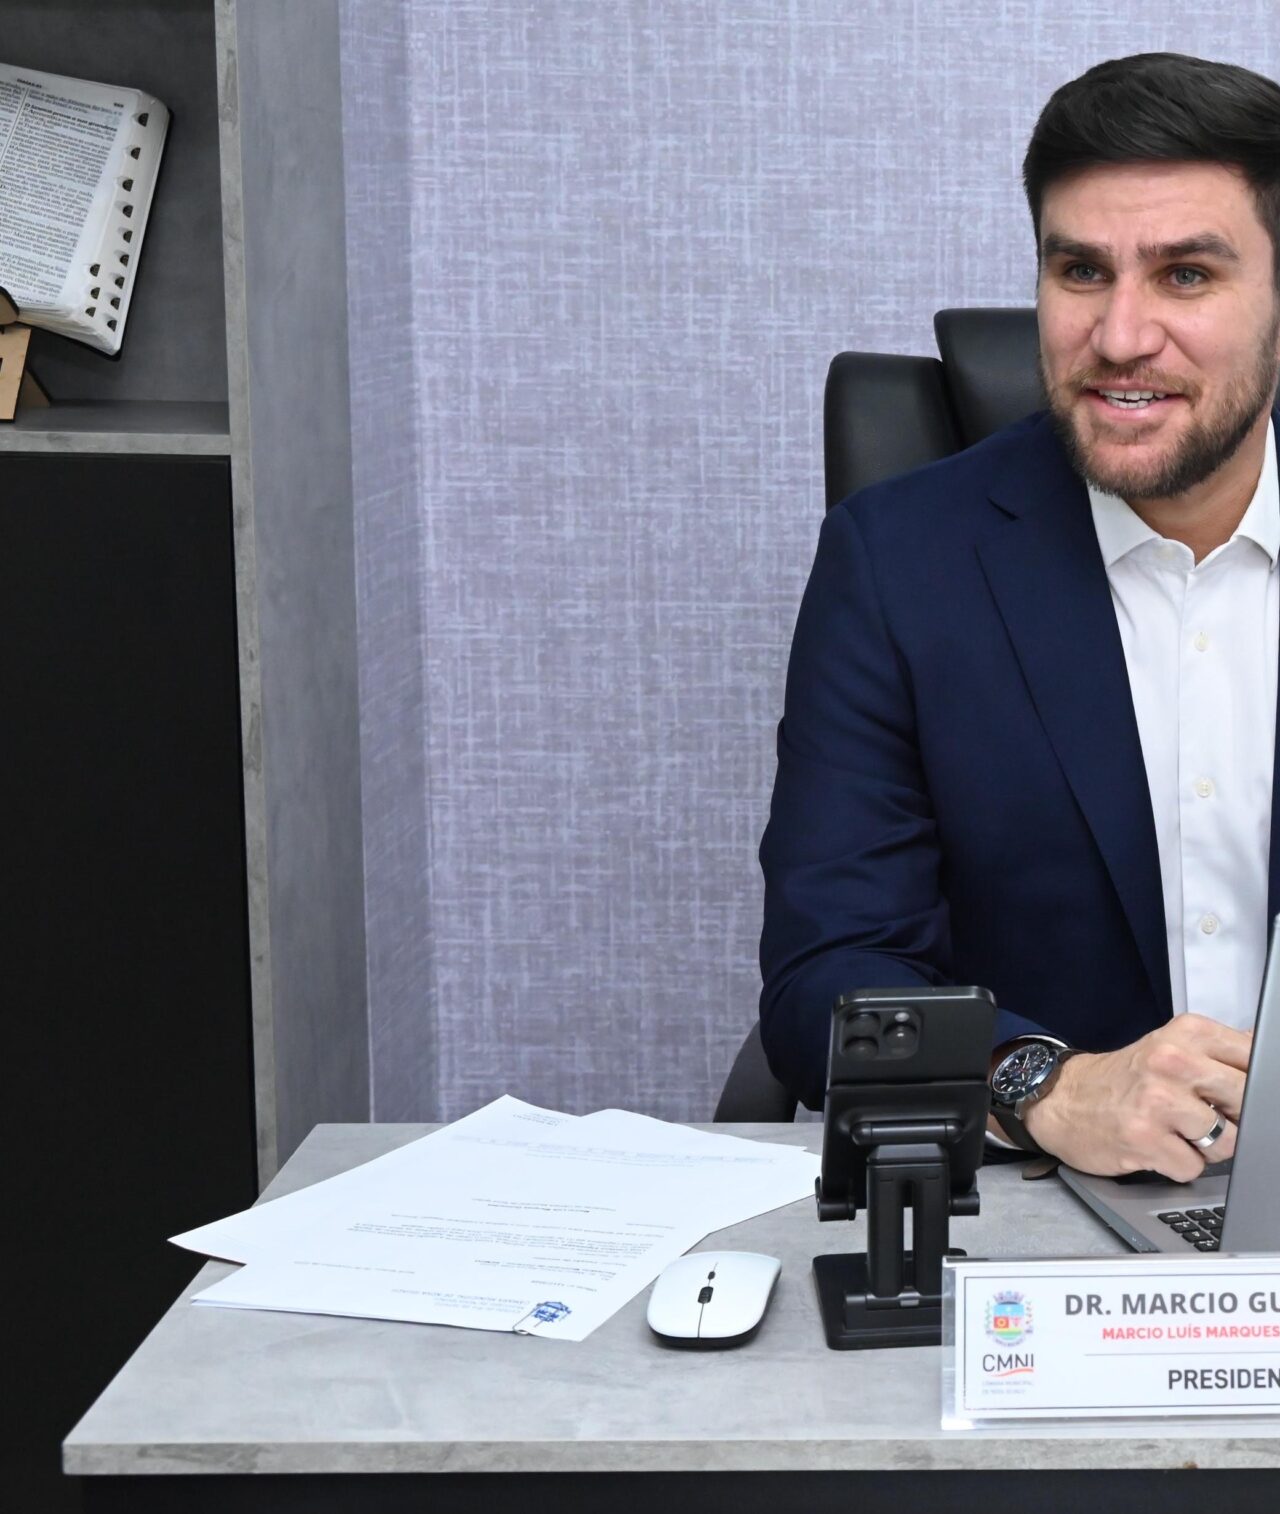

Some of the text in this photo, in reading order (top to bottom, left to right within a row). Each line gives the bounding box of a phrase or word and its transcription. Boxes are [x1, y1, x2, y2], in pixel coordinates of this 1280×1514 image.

[1065, 1294, 1111, 1316] DR.
[1121, 1292, 1238, 1315] MARCIO
[1102, 1327, 1163, 1340] MARCIO
[1167, 1323, 1201, 1339] LUÍS
[1206, 1325, 1280, 1339] MARQUES
[982, 1353, 1034, 1372] CMNI
